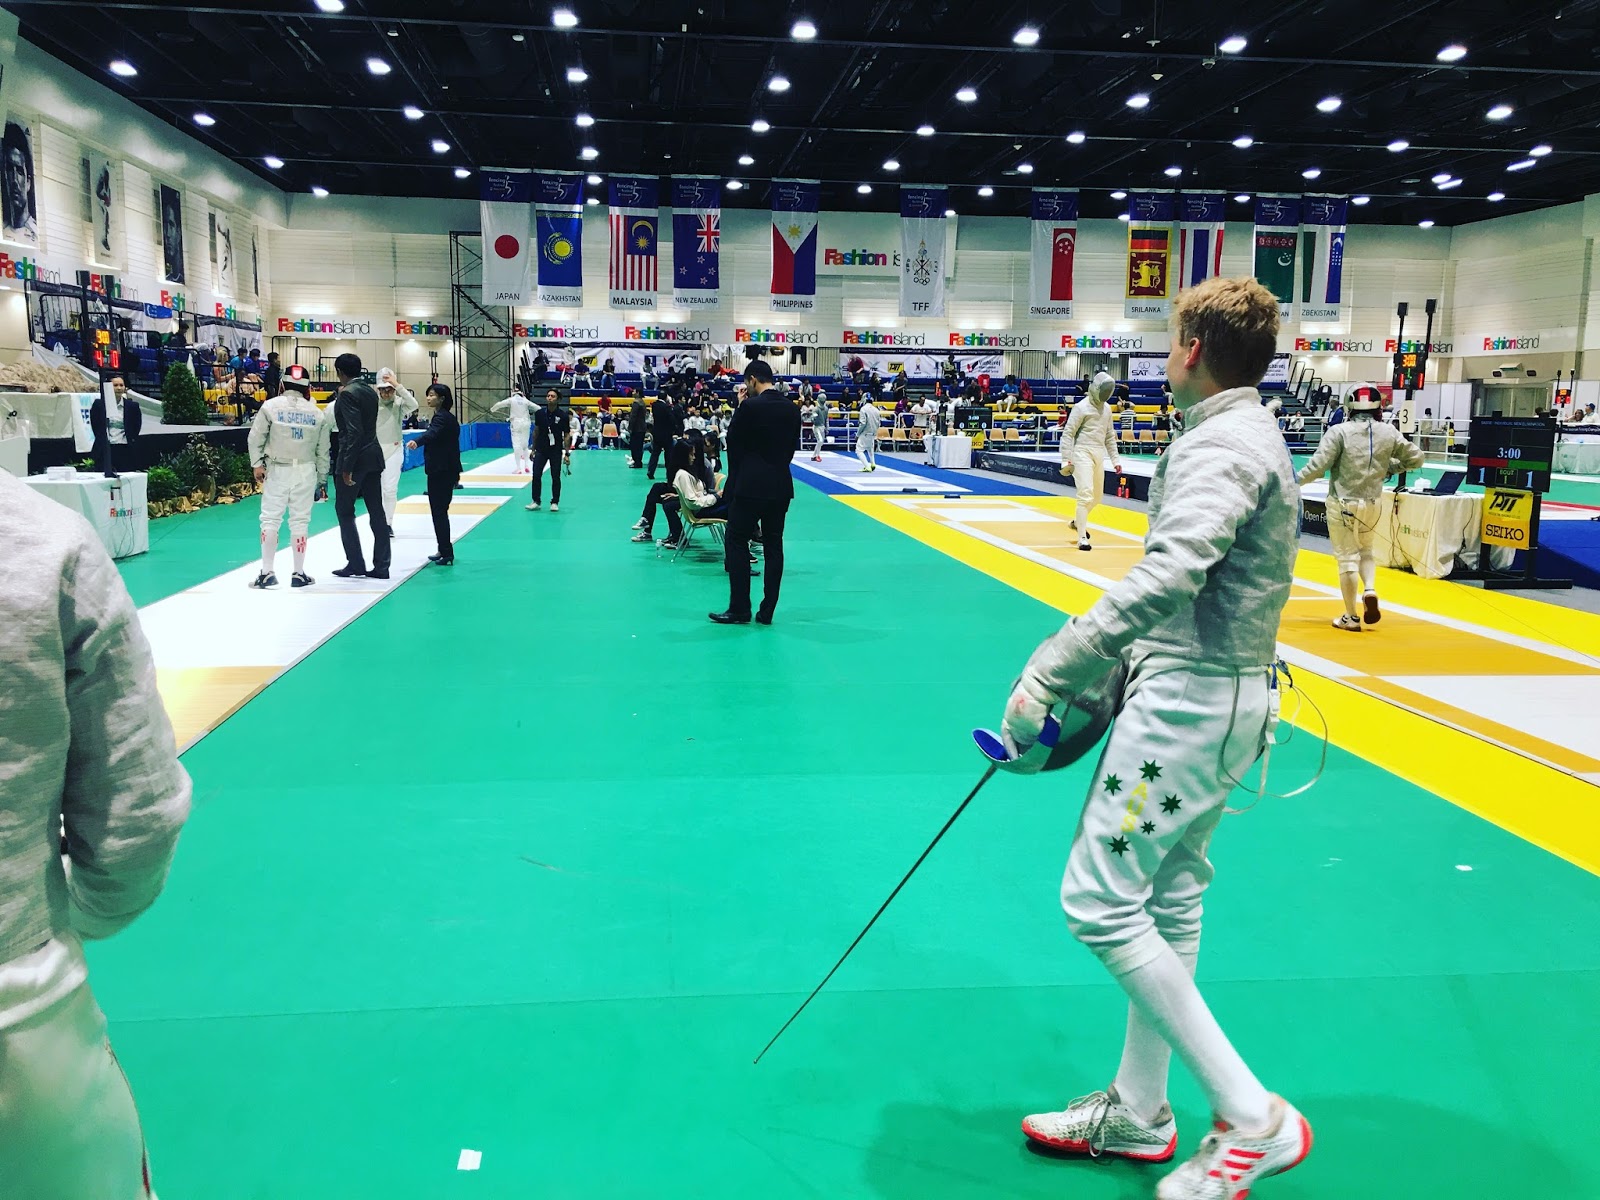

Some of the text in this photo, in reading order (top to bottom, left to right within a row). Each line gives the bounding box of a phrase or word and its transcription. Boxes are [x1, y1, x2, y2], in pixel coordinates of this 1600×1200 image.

[824, 249, 887, 266] Fashion
[495, 292, 520, 301] JAPAN
[613, 297, 653, 306] MALAYSIA
[773, 300, 813, 309] PHILIPPINES
[912, 302, 930, 311] TFF
[1031, 306, 1070, 315] SINGAPORE
[1301, 309, 1337, 317] ZBEKISTAN
[1402, 409, 1408, 424] 3
[291, 427, 303, 440] THA
[1497, 447, 1521, 459] 3:00
[1478, 467, 1485, 484] 1
[1526, 470, 1534, 488] 1
[1304, 510, 1320, 522] Open
[1485, 523, 1524, 541] SEIKO
